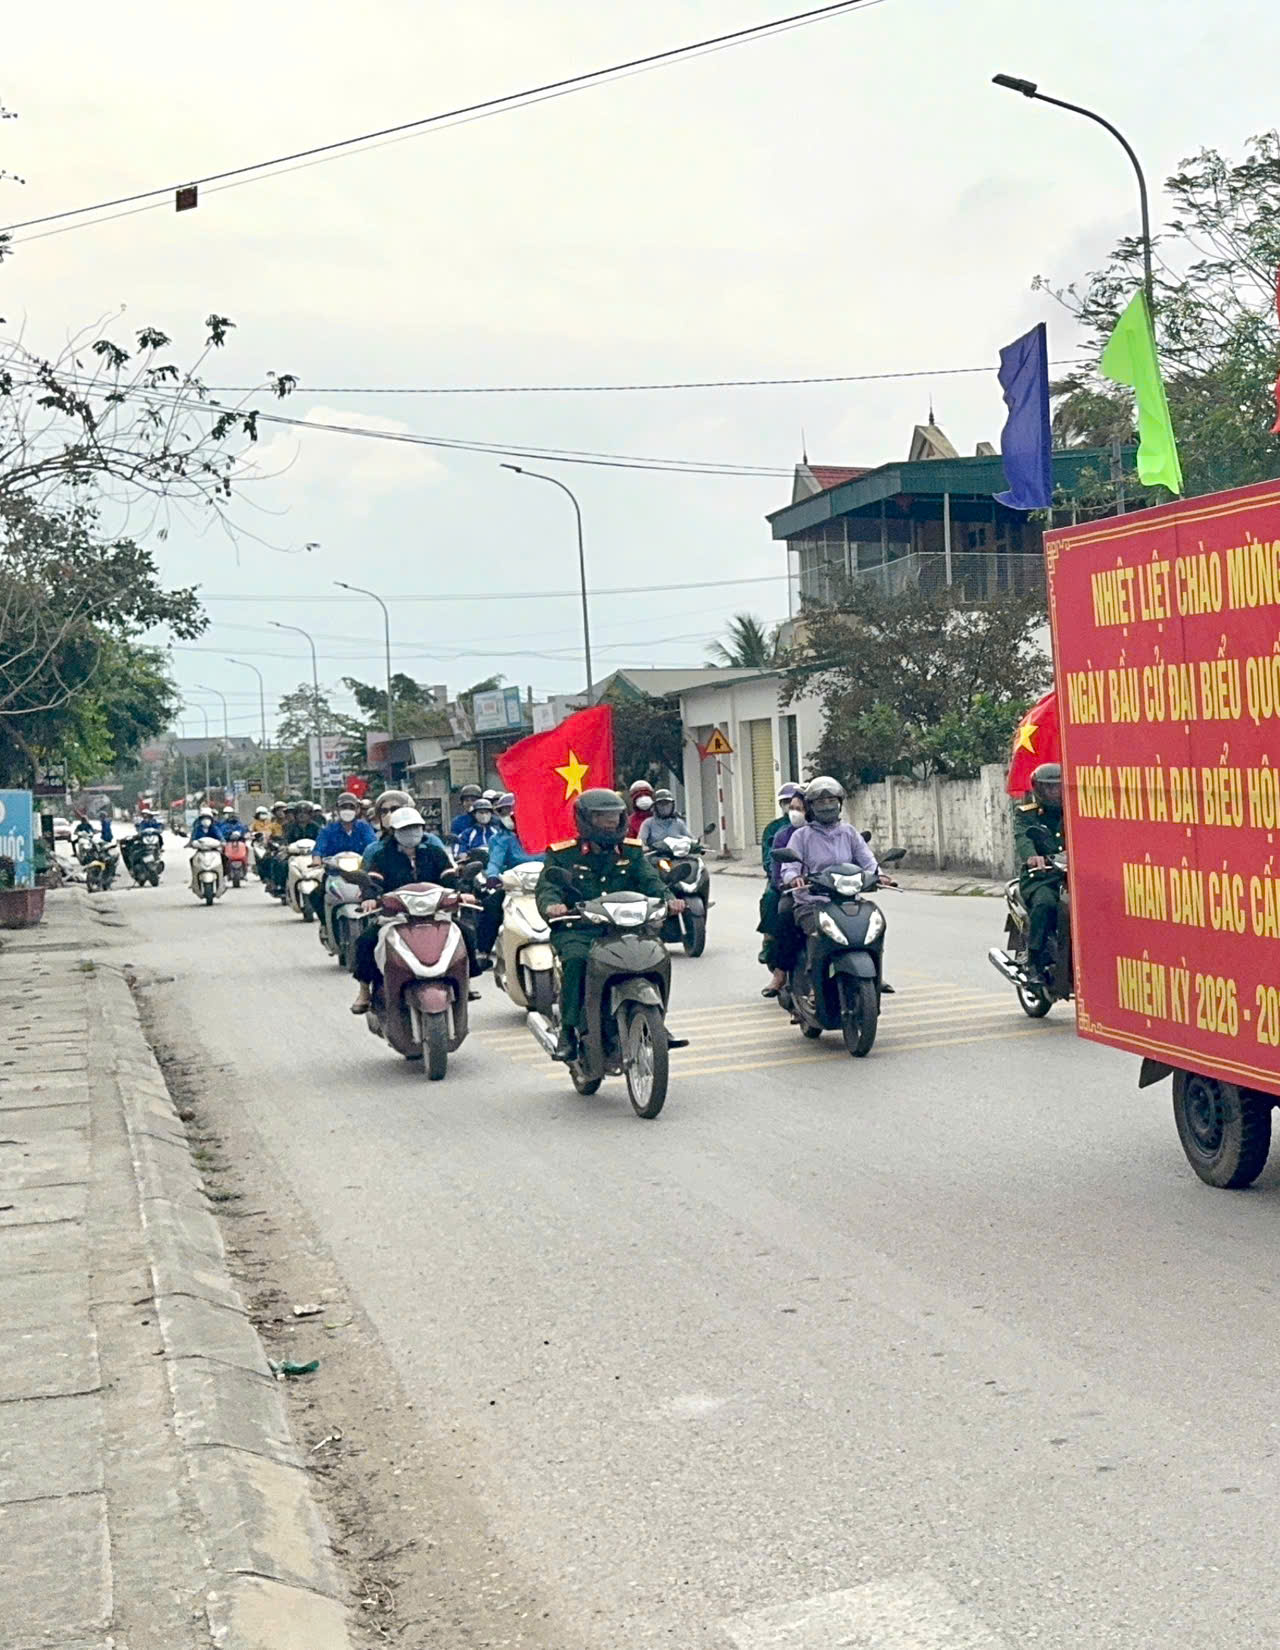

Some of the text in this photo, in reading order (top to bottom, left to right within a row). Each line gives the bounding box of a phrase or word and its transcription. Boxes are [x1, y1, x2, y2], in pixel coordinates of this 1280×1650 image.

[1091, 557, 1135, 636] NHIỆT
[1138, 549, 1171, 632] LIỆT
[1175, 541, 1222, 616] CHÀO
[1067, 660, 1105, 724] NGÀY
[1109, 649, 1140, 723] BẦU
[1143, 646, 1165, 722] CỬ
[1168, 663, 1197, 734] ĐẠI
[1200, 634, 1241, 720] BIỂU
[1076, 755, 1116, 818] KHÓA
[1118, 766, 1143, 820] XVI
[1145, 755, 1168, 822] VÀ
[1170, 767, 1199, 837] ĐẠI
[1202, 742, 1243, 827] BIỂU
[1123, 853, 1167, 920] NHÂN
[1170, 856, 1205, 927] DÂN
[1209, 861, 1245, 934] CÁC
[1117, 949, 1167, 1029] NHIỆM
[1170, 957, 1190, 1025] KỲ
[1195, 973, 1239, 1037] 2026
